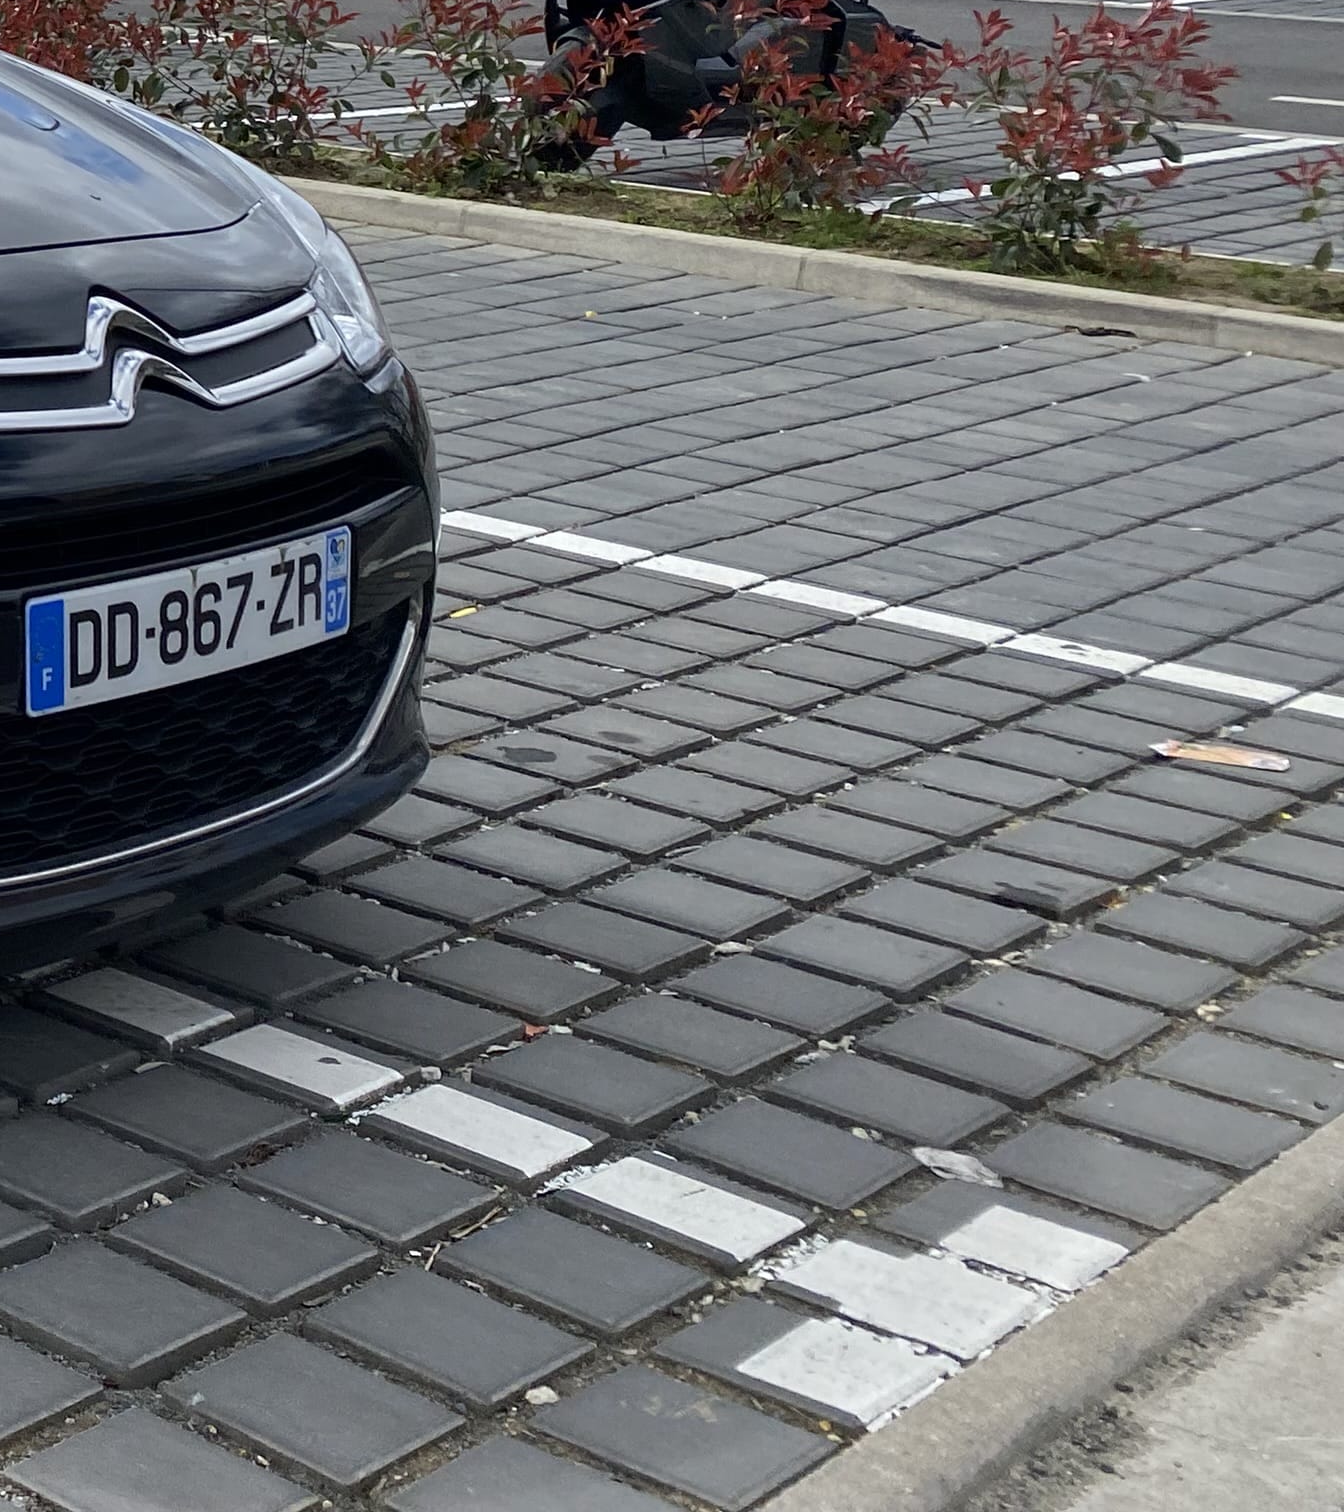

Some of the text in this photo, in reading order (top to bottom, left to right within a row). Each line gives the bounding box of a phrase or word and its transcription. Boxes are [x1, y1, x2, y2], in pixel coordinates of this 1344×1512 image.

[69, 552, 322, 689] DD-867-ZR
[327, 586, 346, 623] 37
[41, 667, 54, 691] F
